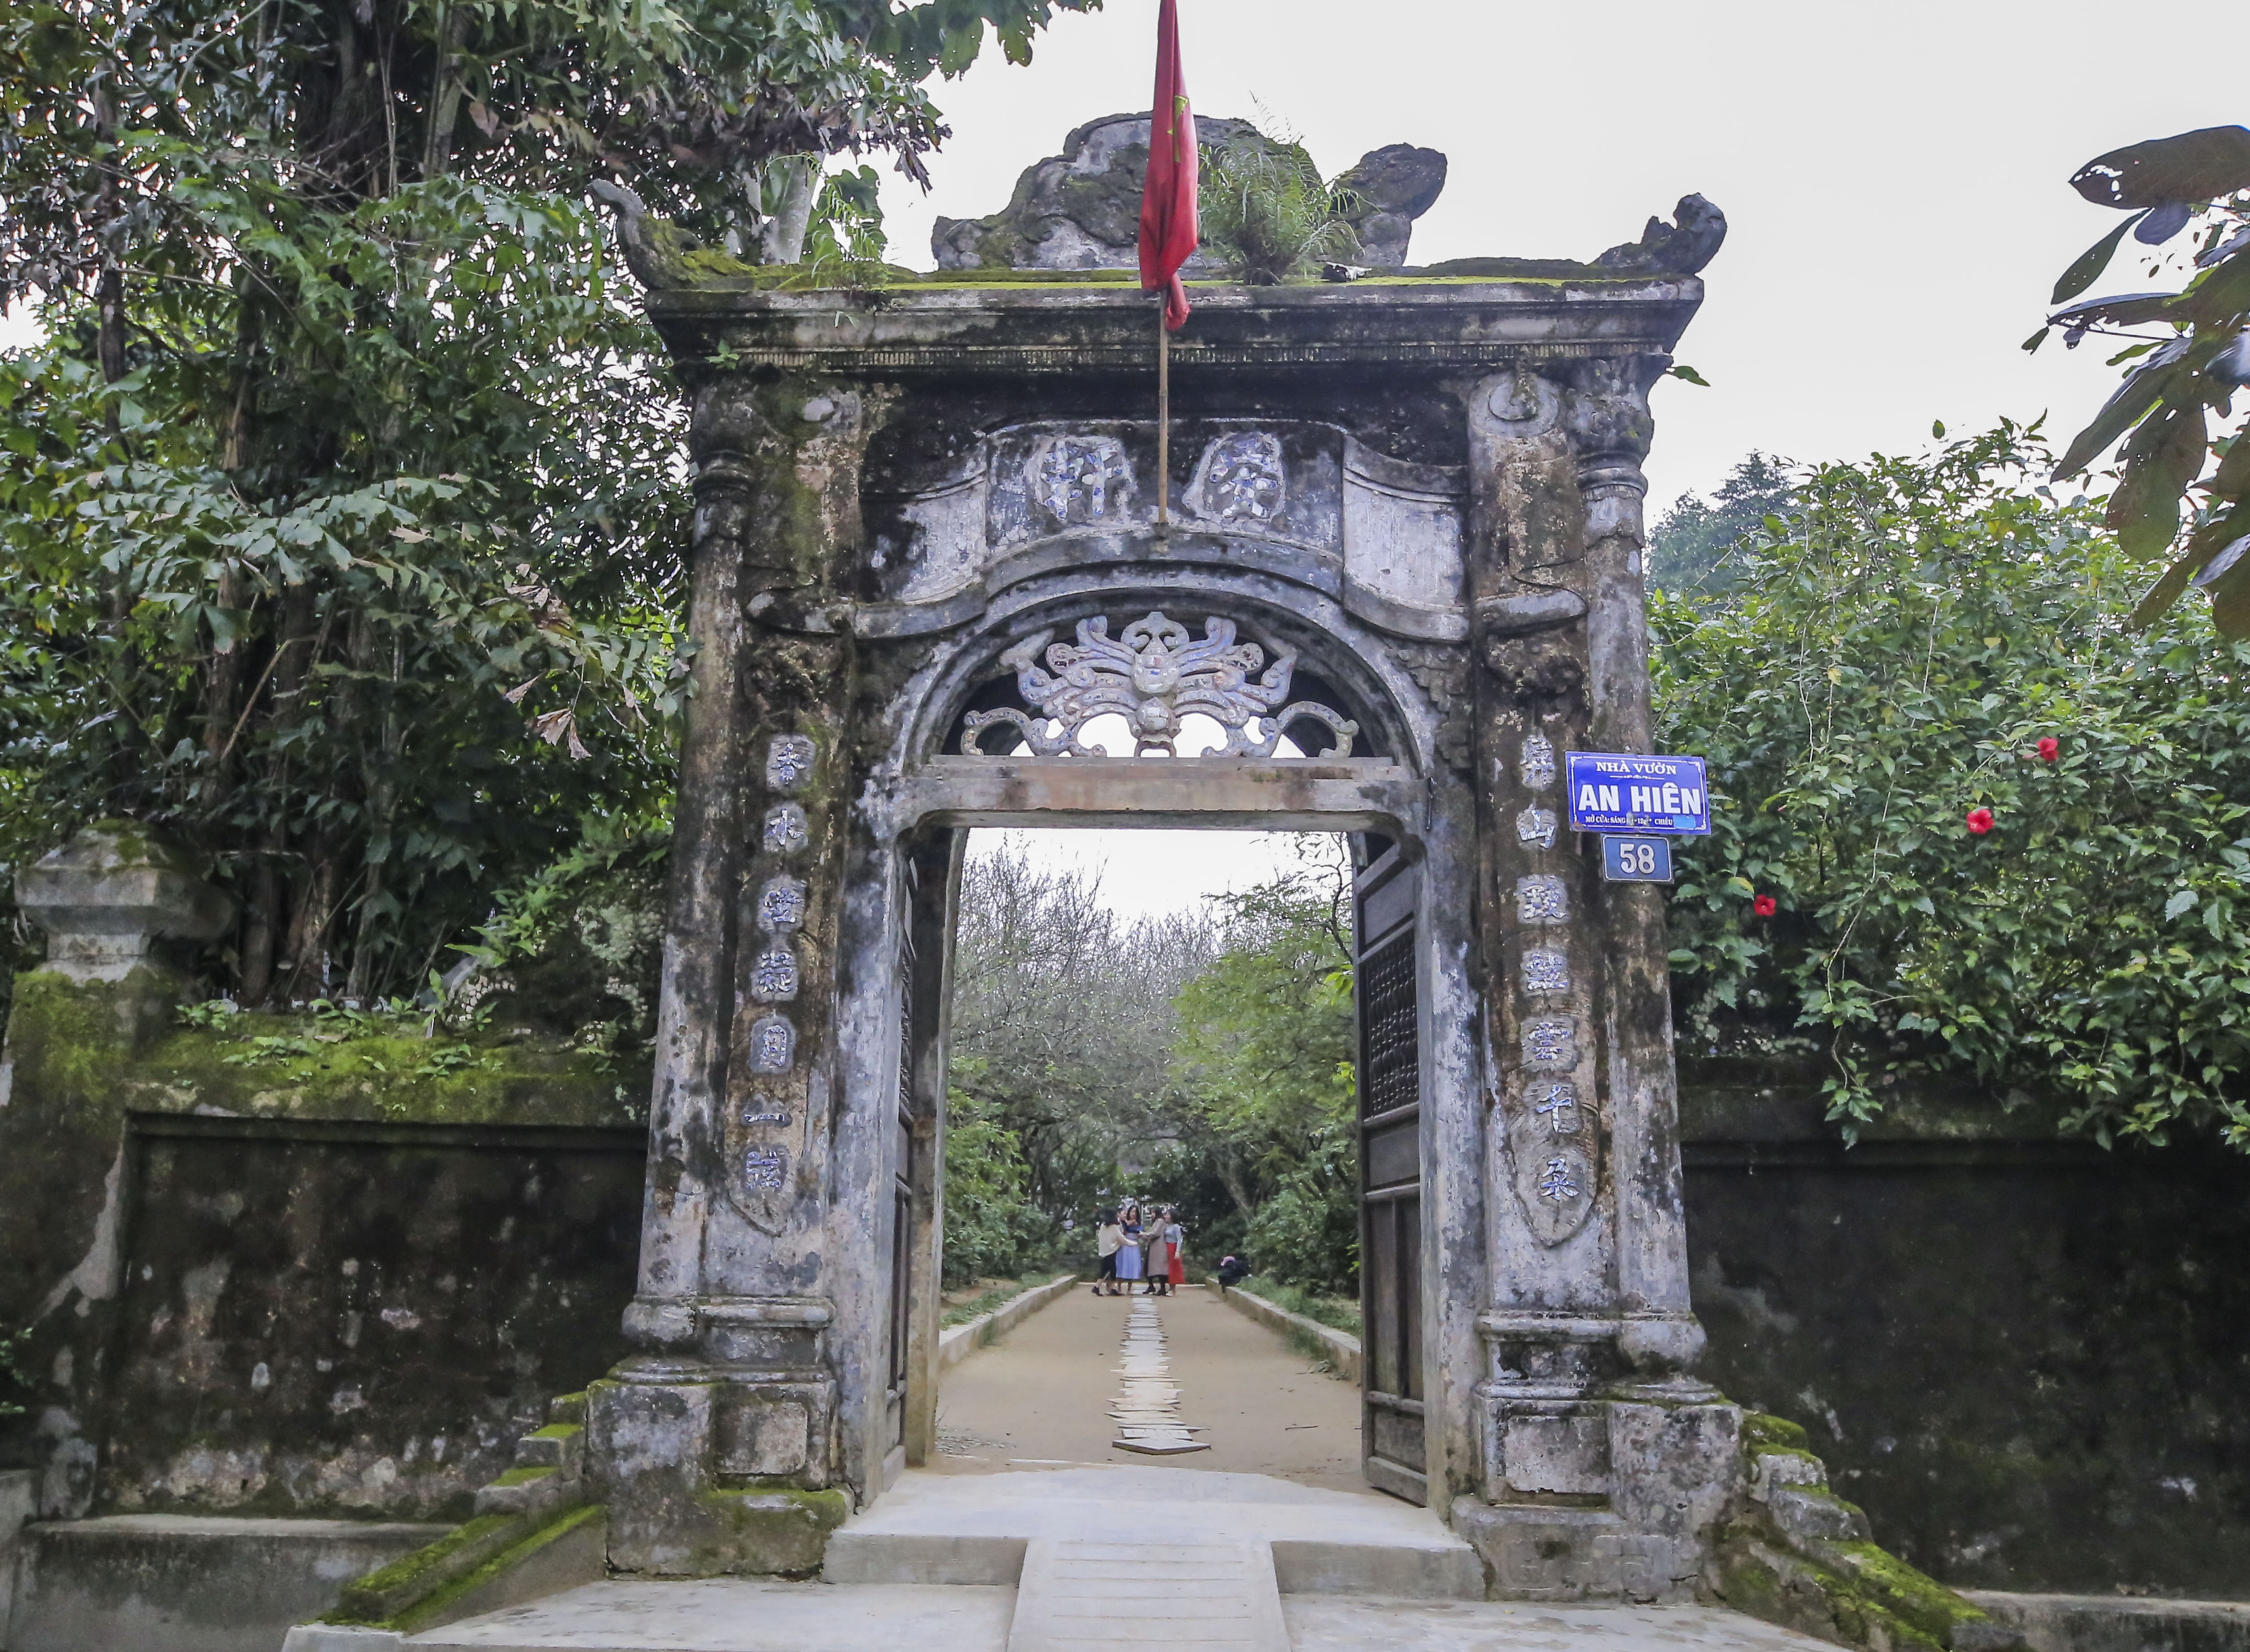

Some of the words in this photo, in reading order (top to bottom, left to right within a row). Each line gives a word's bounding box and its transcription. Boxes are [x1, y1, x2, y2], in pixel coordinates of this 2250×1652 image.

[1595, 760, 1631, 773] NHÀ
[1633, 762, 1677, 775] VƯỜN
[1578, 784, 1620, 812] AN
[1630, 782, 1701, 815] HIÊN
[1620, 843, 1655, 874] 58
